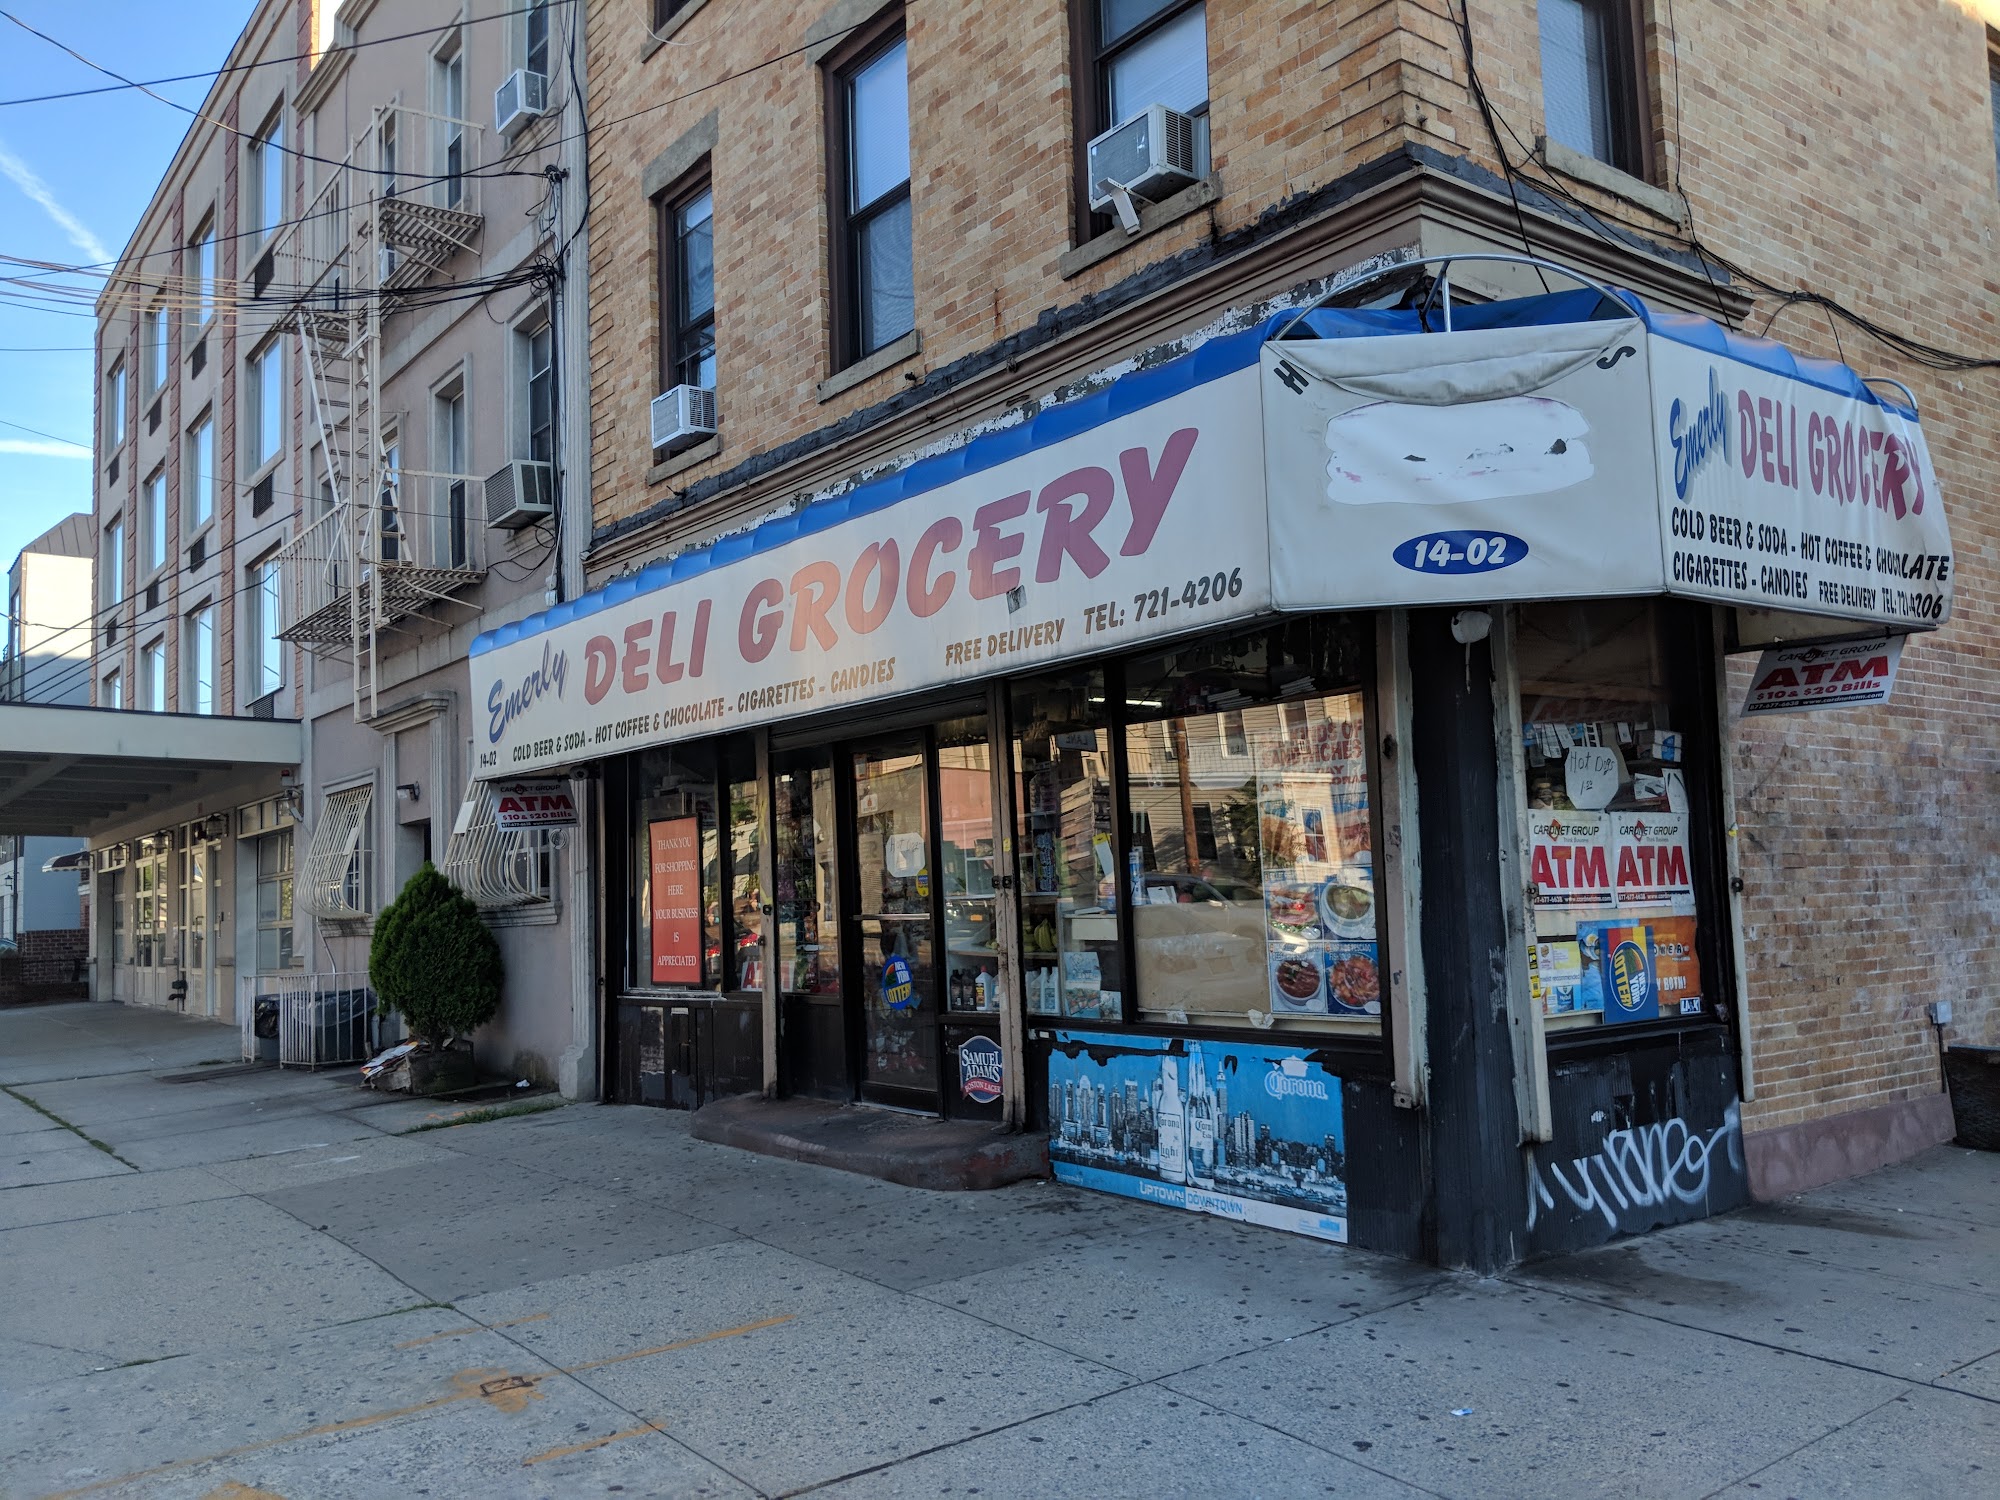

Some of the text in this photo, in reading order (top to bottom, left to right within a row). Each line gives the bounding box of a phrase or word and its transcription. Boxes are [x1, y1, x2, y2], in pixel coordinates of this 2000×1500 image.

[1670, 365, 1925, 521] Emerly DELI GROCERY
[1671, 506, 1705, 541] COLD
[1710, 513, 1742, 550] BEER
[1746, 521, 1754, 550] &
[1758, 523, 1788, 557] SODA
[1801, 532, 1821, 563] HOT
[1825, 537, 1863, 570] COFFEE
[1865, 545, 1872, 572] &
[1413, 536, 1507, 569] 14-02
[488, 427, 1200, 744] Emerly DELI GROCERY
[1673, 550, 1747, 591] CIGARETTES
[1760, 564, 1808, 600] CANDIES
[1819, 580, 1839, 606] FREE
[1841, 583, 1876, 611] DELIVERY
[1882, 587, 1897, 615] TEL:
[1897, 589, 1944, 619] 721-4206
[945, 566, 1243, 668] FREE DELIVERY TEL: 721-4206
[1840, 642, 1887, 656] GROUP
[1754, 655, 1889, 691] ATM
[1756, 690, 1786, 701] $10
[1803, 685, 1838, 697] $20
[1841, 680, 1881, 693] Bills
[512, 744, 532, 763] COLD
[533, 738, 554, 758] BEER
[556, 737, 562, 753] &
[564, 730, 586, 752] SODA
[595, 723, 613, 745] HOT
[615, 715, 650, 740] COFFEE
[653, 712, 660, 732] &
[663, 697, 725, 729] CHOCOLATE
[737, 676, 816, 713] CIGARETTES
[830, 656, 897, 694] CANDIES
[479, 750, 498, 769] 14-02
[1569, 751, 1616, 776] Hot Dogs
[498, 795, 573, 813] ATM
[1533, 825, 1600, 837] CARDNET GROUP
[1619, 825, 1679, 836] CARDNET GROUP
[657, 836, 692, 850] THANK YOU
[655, 860, 696, 874] FOR SHOPPING
[1531, 845, 1611, 889] ATM
[1616, 845, 1690, 888] ATM
[667, 885, 684, 896] HERE
[655, 907, 698, 920] YOUR BUSINESS
[673, 931, 680, 943] IS
[657, 955, 697, 967] APPRECIATED
[894, 961, 906, 971] NEW
[896, 970, 910, 985] YORK
[1613, 949, 1633, 1008] LOTTERY
[1663, 975, 1687, 991] BOTH!
[961, 1048, 1003, 1068] SAMUEL
[965, 1064, 1001, 1083] ADAMS
[964, 1080, 984, 1093] BOSTON
[1264, 1069, 1329, 1100] Corona
[1160, 1142, 1179, 1159] Light
[1139, 1180, 1243, 1215] UPTOWN DOWNTOWN
